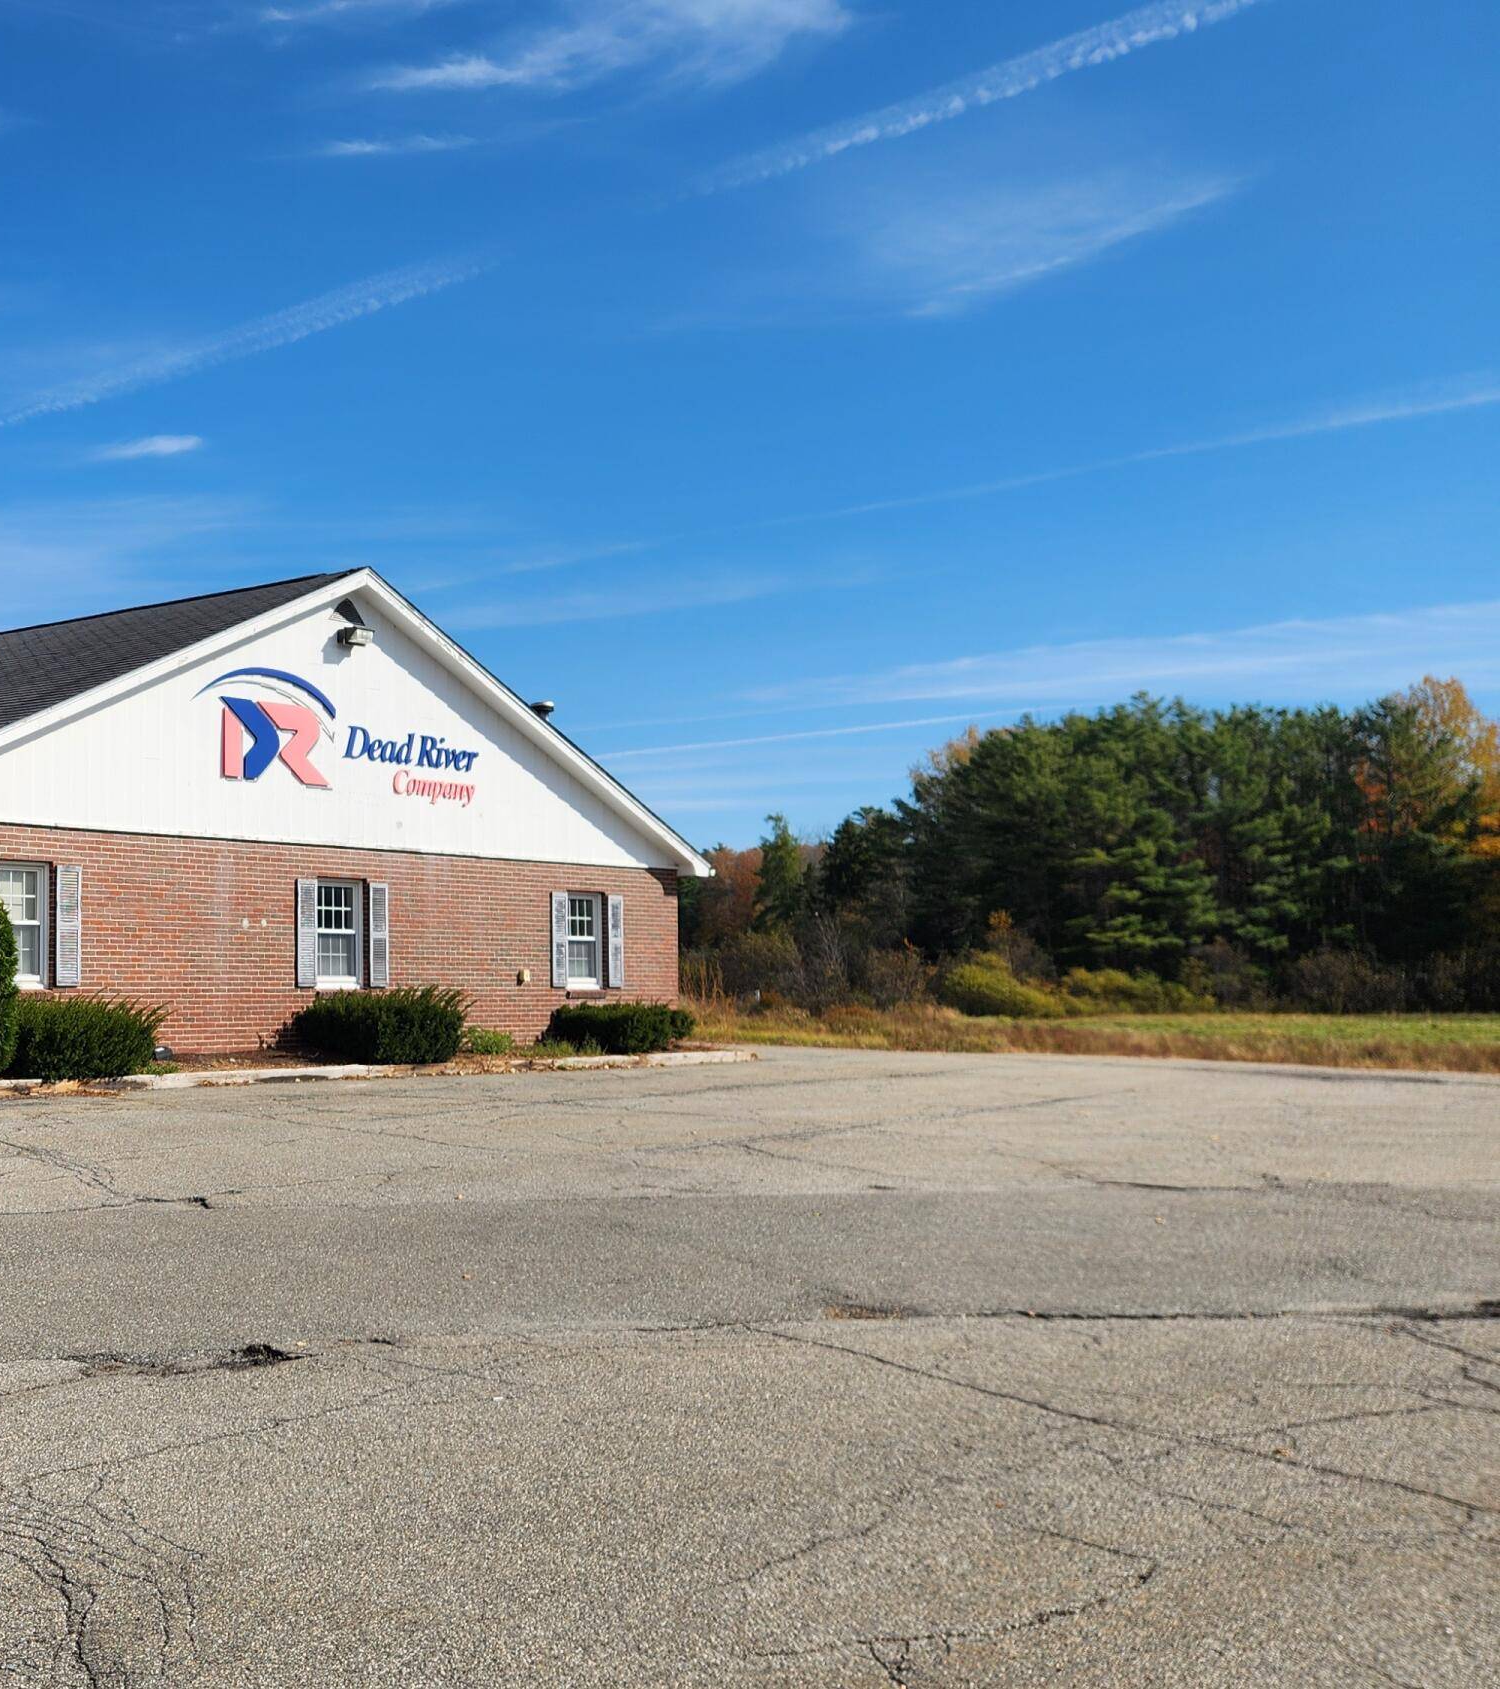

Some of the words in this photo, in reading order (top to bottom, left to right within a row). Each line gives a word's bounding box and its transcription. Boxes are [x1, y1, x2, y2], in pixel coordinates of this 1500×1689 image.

[342, 725, 415, 766] Dead
[417, 735, 479, 773] River
[392, 770, 476, 808] Company
